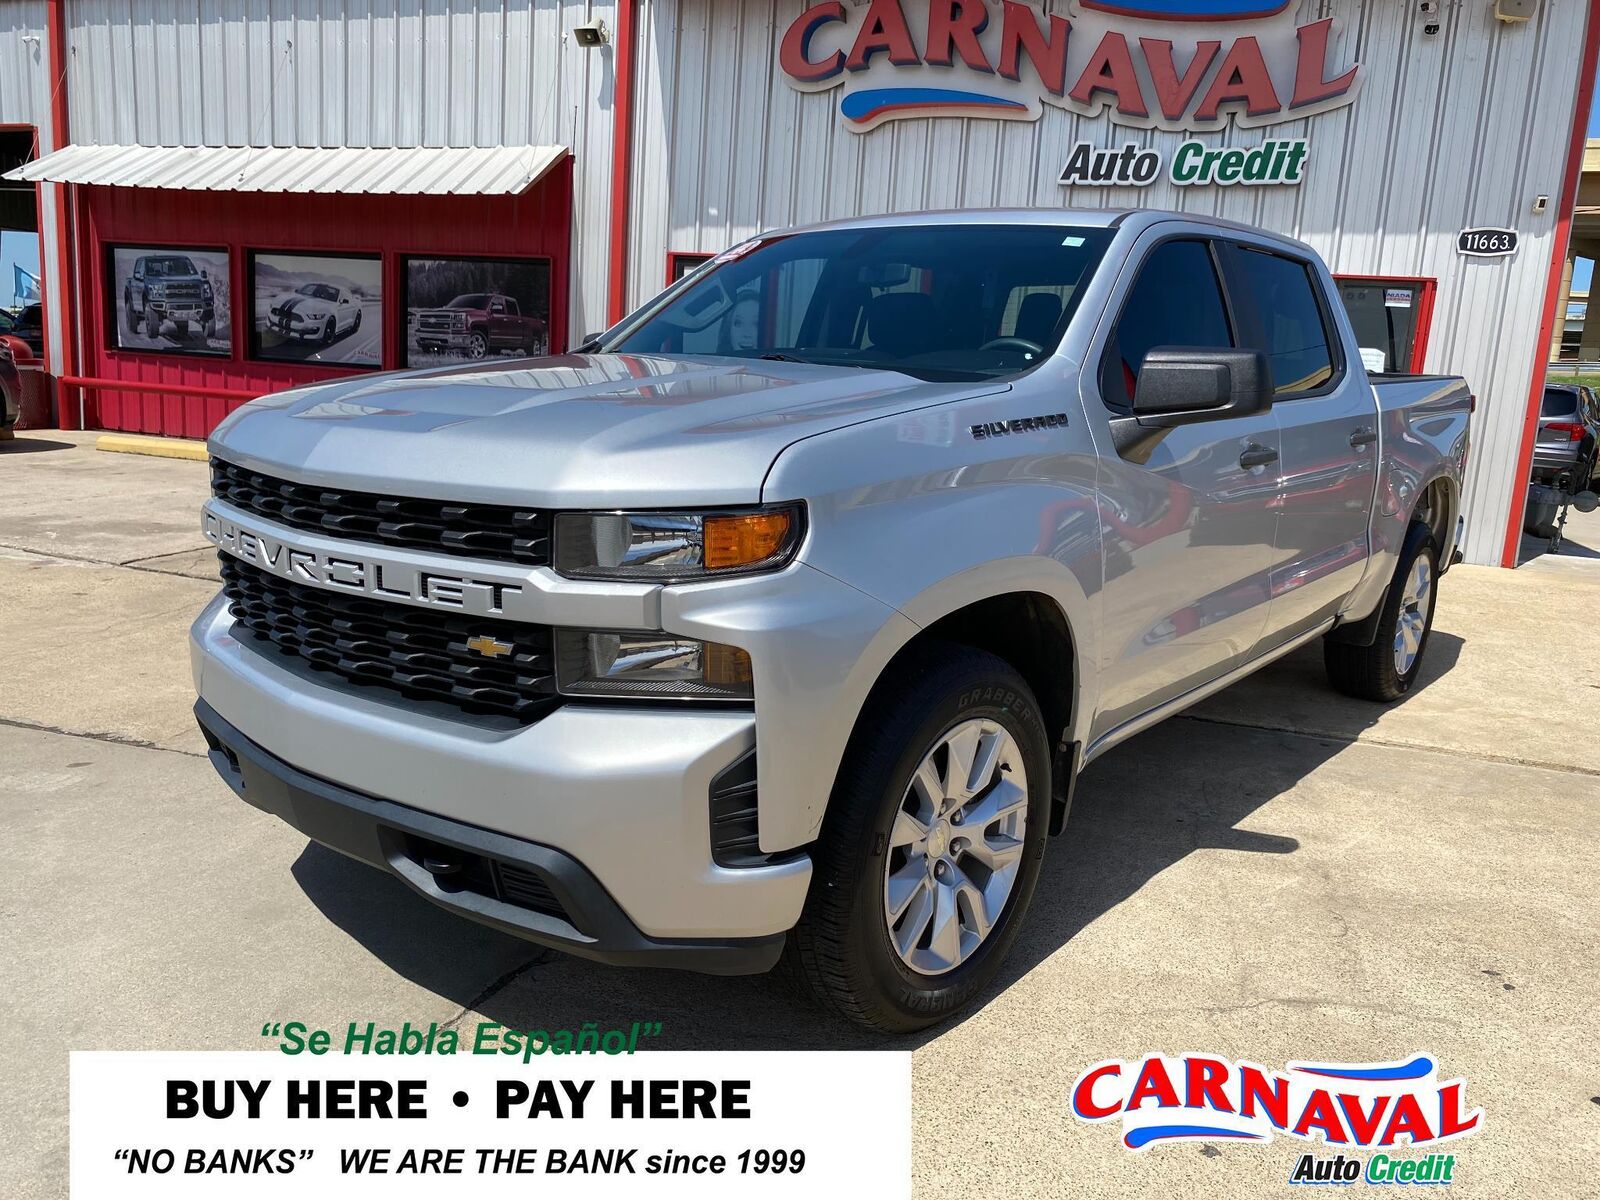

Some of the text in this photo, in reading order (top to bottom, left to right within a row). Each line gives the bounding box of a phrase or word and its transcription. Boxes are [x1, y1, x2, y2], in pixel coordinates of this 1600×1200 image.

[780, 0, 1360, 122] CARNAVAL
[1060, 141, 1306, 182] Auto Credit
[1466, 234, 1509, 250] 11663
[968, 412, 1069, 439] SILVERADO
[204, 511, 523, 614] CHEVROLET
[958, 687, 1031, 721] GRABBER
